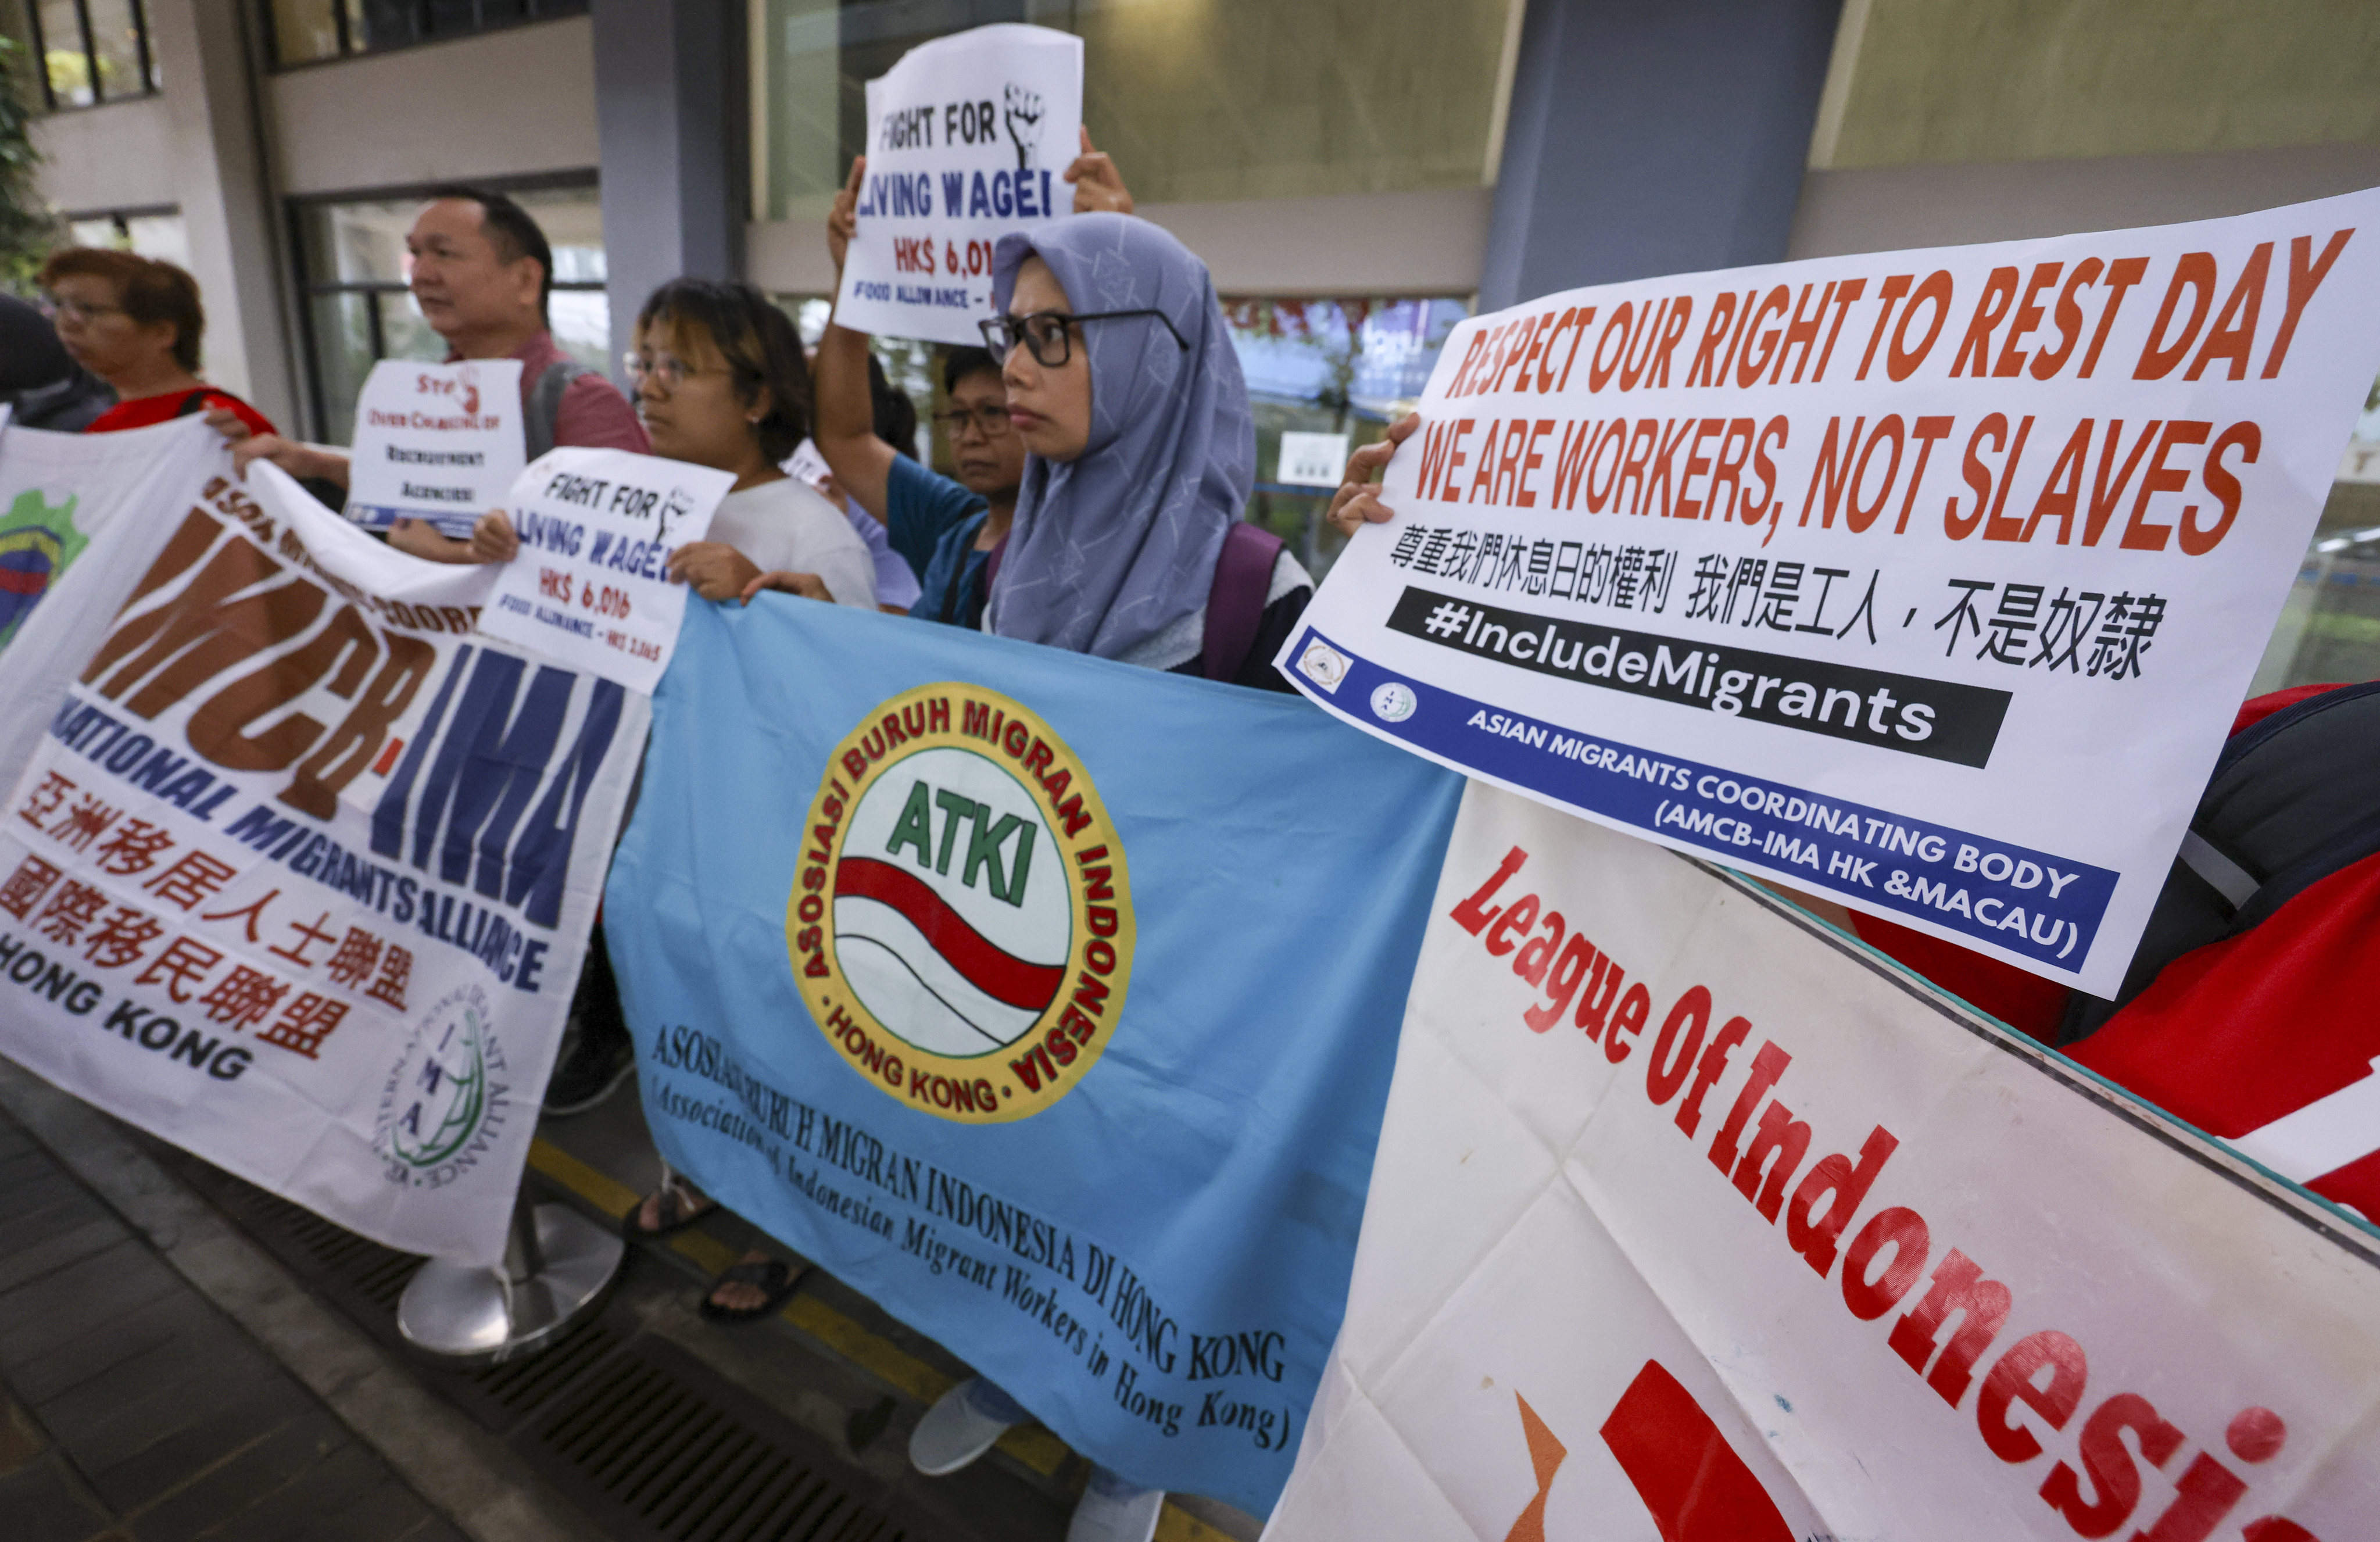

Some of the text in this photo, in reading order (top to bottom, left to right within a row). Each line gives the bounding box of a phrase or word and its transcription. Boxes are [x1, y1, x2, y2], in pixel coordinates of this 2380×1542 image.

[880, 100, 997, 152] FIGHT FOR
[894, 236, 995, 281] HK$ 6,01
[1445, 306, 1597, 399] RESPECT
[1588, 296, 1692, 393] OUR
[1685, 278, 1868, 388] RIGHT
[1855, 269, 1953, 382] TO
[1949, 256, 2150, 381] REST
[2132, 227, 2356, 381] DAY
[517, 509, 584, 556] LIVING
[545, 473, 659, 518] FIGHT FOR
[1416, 412, 2262, 556] WE ARE WORKERS, NOT SLAVES
[539, 566, 572, 604] HK$
[1390, 524, 1678, 614] 尊重我們休息日的權利
[1425, 602, 1936, 742] #IncludeMigrants
[885, 779, 1037, 908] ATKI
[1467, 709, 2080, 900] ASIAN MIGRANTS COORDINATING BODY
[17, 770, 413, 1012] 亞洲移居人士聯盟
[224, 804, 417, 923] MIGRANTS
[417, 889, 550, 993] ALLIANCE
[797, 697, 1119, 1094] ASOSIASI BURUH MIGRAN INDONESIA
[1655, 800, 2078, 960] (AMCB-IMA HK &MACAU)
[0, 853, 351, 1061] 國際移民聯盟
[0, 932, 253, 1081] HONG KONG
[826, 1004, 998, 1113] HONG KONG
[817, 1114, 921, 1204] MIGRAN
[925, 1167, 1075, 1282] INDONESIA
[1082, 1243, 1116, 1307] DI
[1110, 1265, 1178, 1373] HONG
[1187, 1331, 1286, 1382] KONG
[1450, 845, 2321, 1542] League Of Indonesi
[788, 1155, 894, 1241] Indonesian
[901, 1217, 997, 1291] Migrant
[1003, 1264, 1087, 1356] Workers
[1087, 1333, 1110, 1379] in
[1114, 1359, 1183, 1437] Hong
[1197, 1390, 1290, 1451] Kong)
